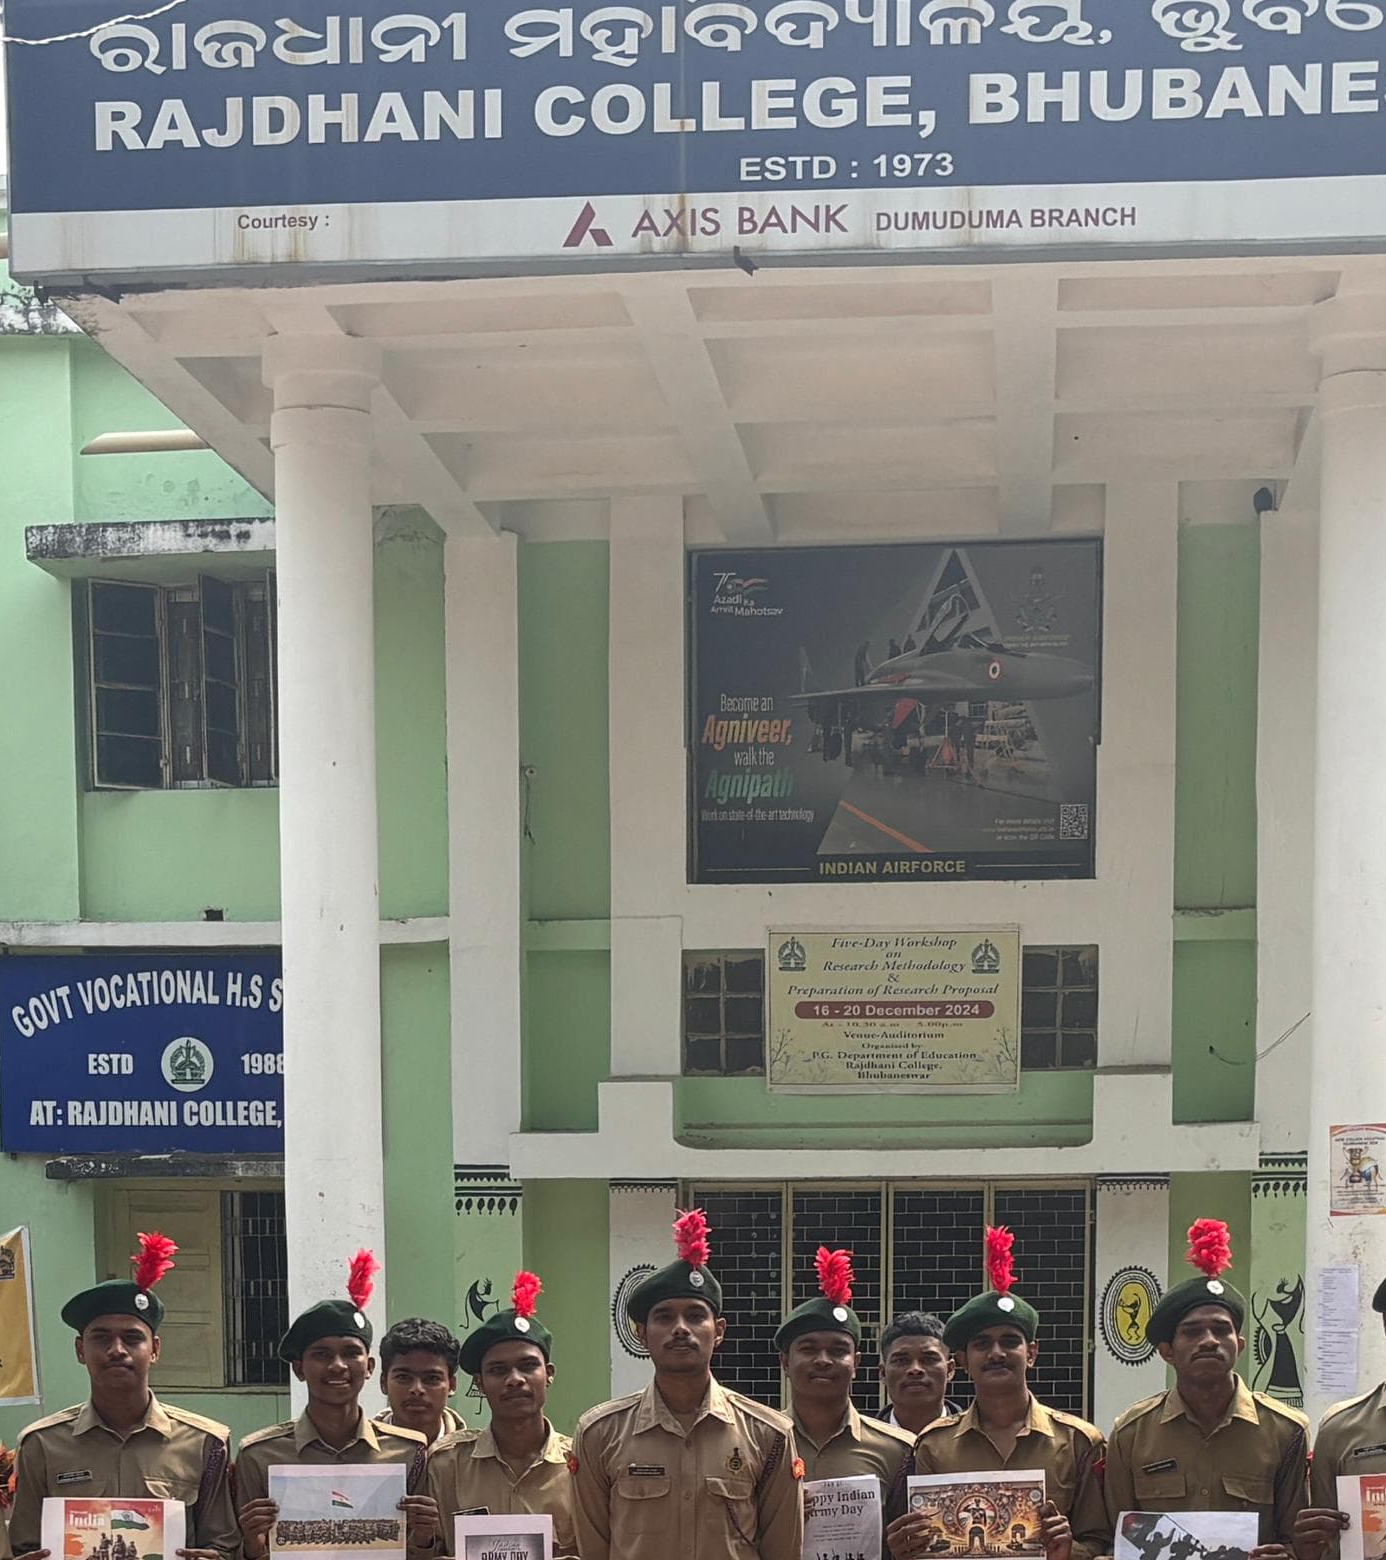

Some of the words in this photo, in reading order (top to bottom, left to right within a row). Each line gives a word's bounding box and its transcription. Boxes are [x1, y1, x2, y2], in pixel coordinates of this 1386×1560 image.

[94, 88, 503, 152] RAJDHANI
[534, 75, 937, 139] COLLEGE,
[739, 155, 837, 182] ESTD
[872, 152, 955, 178] 1973
[237, 212, 319, 233] Courtesy
[632, 206, 721, 238] AXIS
[736, 204, 849, 235] BANK
[874, 208, 1025, 233] DUMUDUMA
[1029, 206, 1137, 230] BRANCH
[720, 694, 760, 712] Become
[761, 697, 774, 711] an
[702, 713, 793, 751] Agniveer,
[734, 747, 758, 766] walk
[759, 747, 775, 766] the
[705, 767, 793, 804] Agnipath
[819, 862, 877, 876] INDIAN
[882, 860, 966, 874] AIRFORCE
[831, 937, 891, 951] Five-Day
[894, 936, 957, 949] Workshop
[885, 951, 902, 959] on
[822, 961, 879, 972] Research
[882, 960, 966, 974] Methodology
[787, 985, 863, 998] Preparation
[866, 984, 881, 999] of
[882, 984, 939, 996] Research
[942, 983, 999, 998] Proposal
[11, 985, 74, 1039] GOVT
[76, 969, 220, 1015] VOCATIONAL
[813, 1005, 830, 1016] 16
[843, 1005, 861, 1017] 20
[865, 1004, 941, 1016] December
[944, 1004, 980, 1016] 2024
[843, 1031, 945, 1040] Venue-Auditorium
[837, 1051, 903, 1061] Department
[921, 1050, 978, 1060] Education
[87, 1053, 134, 1076] ESTD
[845, 1060, 895, 1071] Rajdhani
[857, 1071, 931, 1080] Bhubaneswar
[29, 1100, 63, 1127] AT:
[67, 1100, 178, 1127] RAJDHANI
[182, 1100, 283, 1129] COLLEGE,
[836, 1488, 876, 1503] Indian
[841, 1504, 864, 1516] Day
